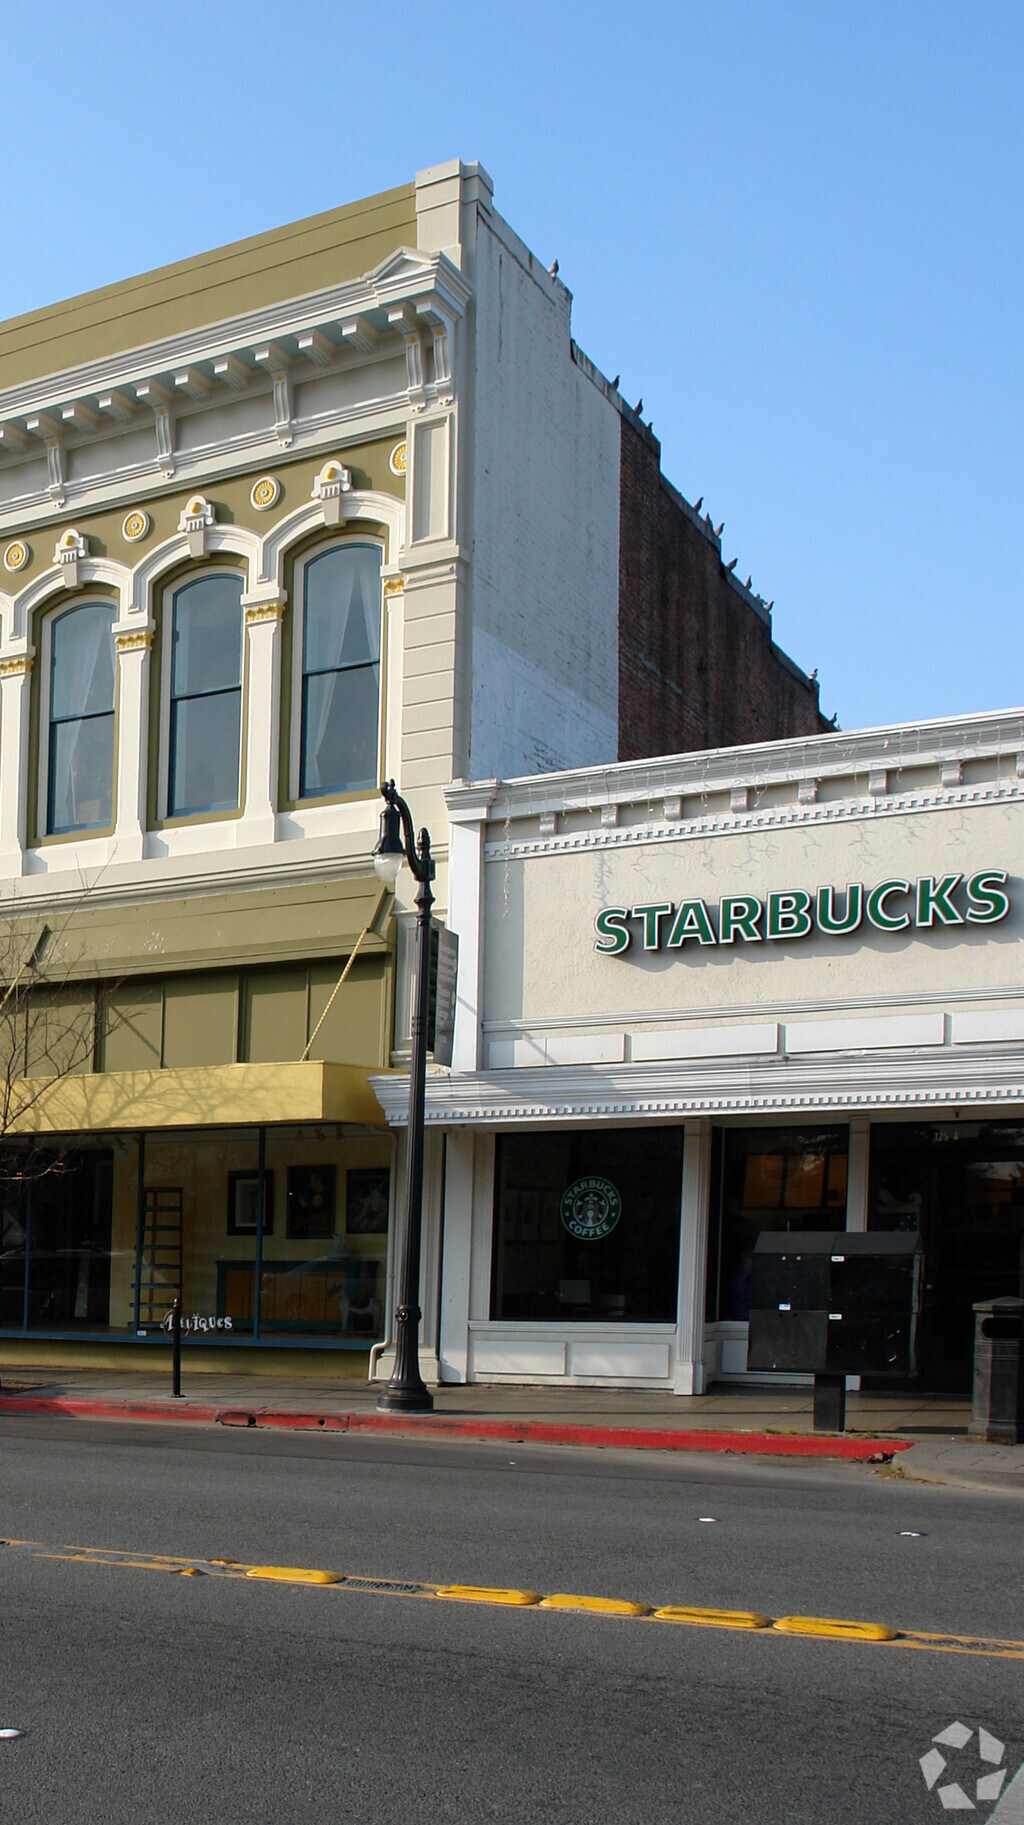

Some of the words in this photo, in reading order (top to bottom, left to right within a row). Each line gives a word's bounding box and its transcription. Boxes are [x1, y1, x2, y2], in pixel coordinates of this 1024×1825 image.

[593, 869, 1010, 956] STARBUCKS
[564, 1180, 618, 1206] STARBUCKS
[568, 1221, 610, 1237] COFFEE
